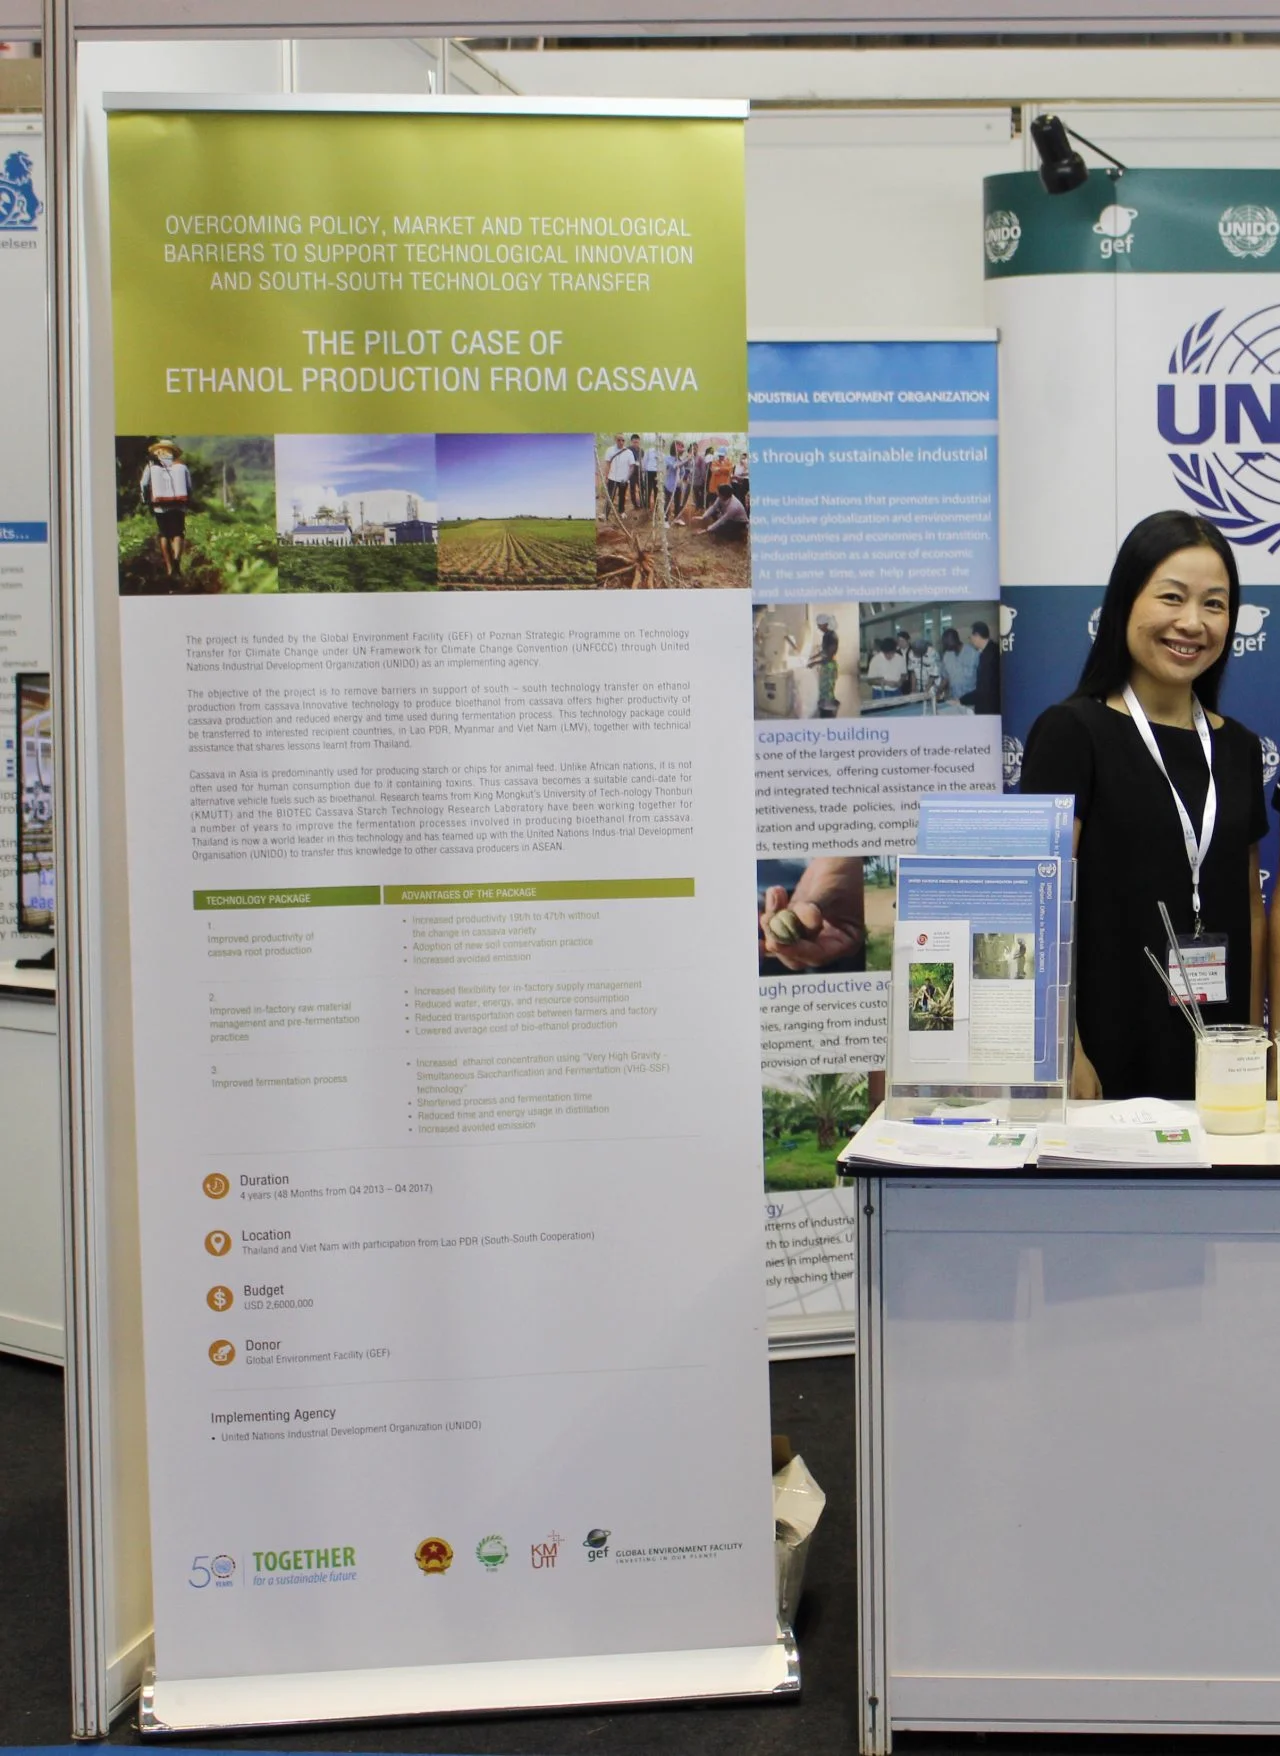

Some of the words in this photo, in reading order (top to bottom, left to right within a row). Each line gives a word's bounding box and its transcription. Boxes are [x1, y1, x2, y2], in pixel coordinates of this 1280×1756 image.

[166, 215, 301, 236] OVERCOMING
[310, 216, 385, 236] POLICY,
[392, 216, 474, 237] MARKET
[482, 217, 522, 237] AND
[529, 216, 691, 237] TECHNOLOGICAL
[1219, 221, 1280, 238] UNIDO
[164, 242, 264, 264] BARRIERS
[272, 243, 296, 264] TO
[302, 244, 397, 265] SUPPORT
[404, 244, 567, 265] TECHNOLOGICAL
[576, 244, 692, 265] INNOVATION
[1100, 234, 1134, 258] gef
[210, 268, 254, 289] AND
[258, 271, 402, 291] SOUTH-SOUTH
[409, 272, 542, 290] TECHNOLOGY
[548, 273, 649, 290] TRANSFER
[302, 330, 354, 354] THE
[365, 330, 442, 354] PILOT
[451, 330, 520, 354] CASE
[530, 330, 562, 354] OF
[166, 368, 292, 392] ETHANOL
[302, 367, 479, 391] PRODUCTION
[490, 367, 566, 391] FROM
[577, 367, 698, 390] CASSAVA
[748, 392, 809, 403] NDUSTRIAL
[813, 391, 894, 403] DEVELOPMENT
[898, 391, 990, 403] ORGANIZATION
[763, 449, 824, 466] through
[829, 448, 913, 463] sustainable
[918, 447, 988, 462] industrial
[1233, 632, 1266, 657] gef
[758, 728, 889, 744] capacity-building
[762, 752, 783, 760] one
[786, 749, 796, 759] of
[799, 749, 816, 759] the
[819, 749, 854, 760] largest
[858, 747, 908, 759] providers
[910, 746, 920, 756] of
[923, 745, 990, 755] trade-related
[206, 894, 266, 905] TECHNOLOGY
[268, 893, 311, 904] PACKAGE
[401, 889, 461, 900] ADVANTAGES
[462, 888, 474, 899] OF
[476, 887, 493, 898] THE
[495, 886, 537, 898] PACKAGE
[240, 1174, 288, 1185] Duration
[240, 1191, 245, 1199] 4
[248, 1192, 271, 1200] years
[274, 1189, 288, 1199] (48
[290, 1189, 323, 1197] Months
[349, 1185, 360, 1194] Q4
[363, 1185, 384, 1193] 2013
[394, 1184, 406, 1192] Q4
[409, 1184, 432, 1192] 2017)
[242, 1230, 290, 1241] Location
[244, 1285, 284, 1297] Budget
[243, 1300, 263, 1311] USD
[246, 1339, 280, 1350] Donor
[246, 1355, 273, 1364] Global
[276, 1353, 330, 1363] Environment
[333, 1351, 363, 1359] Facility
[366, 1348, 390, 1359] (GEF)
[211, 1411, 290, 1424] Implementing
[294, 1409, 336, 1421] Agency
[531, 1543, 557, 1556] KM
[588, 1547, 610, 1562] gef
[616, 1549, 646, 1558] GLOBAL
[648, 1545, 708, 1556] ENVIRONMENT
[710, 1543, 743, 1553] FACILITY
[252, 1547, 356, 1572] TOGETHER
[253, 1575, 266, 1586] for
[276, 1572, 327, 1585] sustainable
[329, 1571, 357, 1583] future
